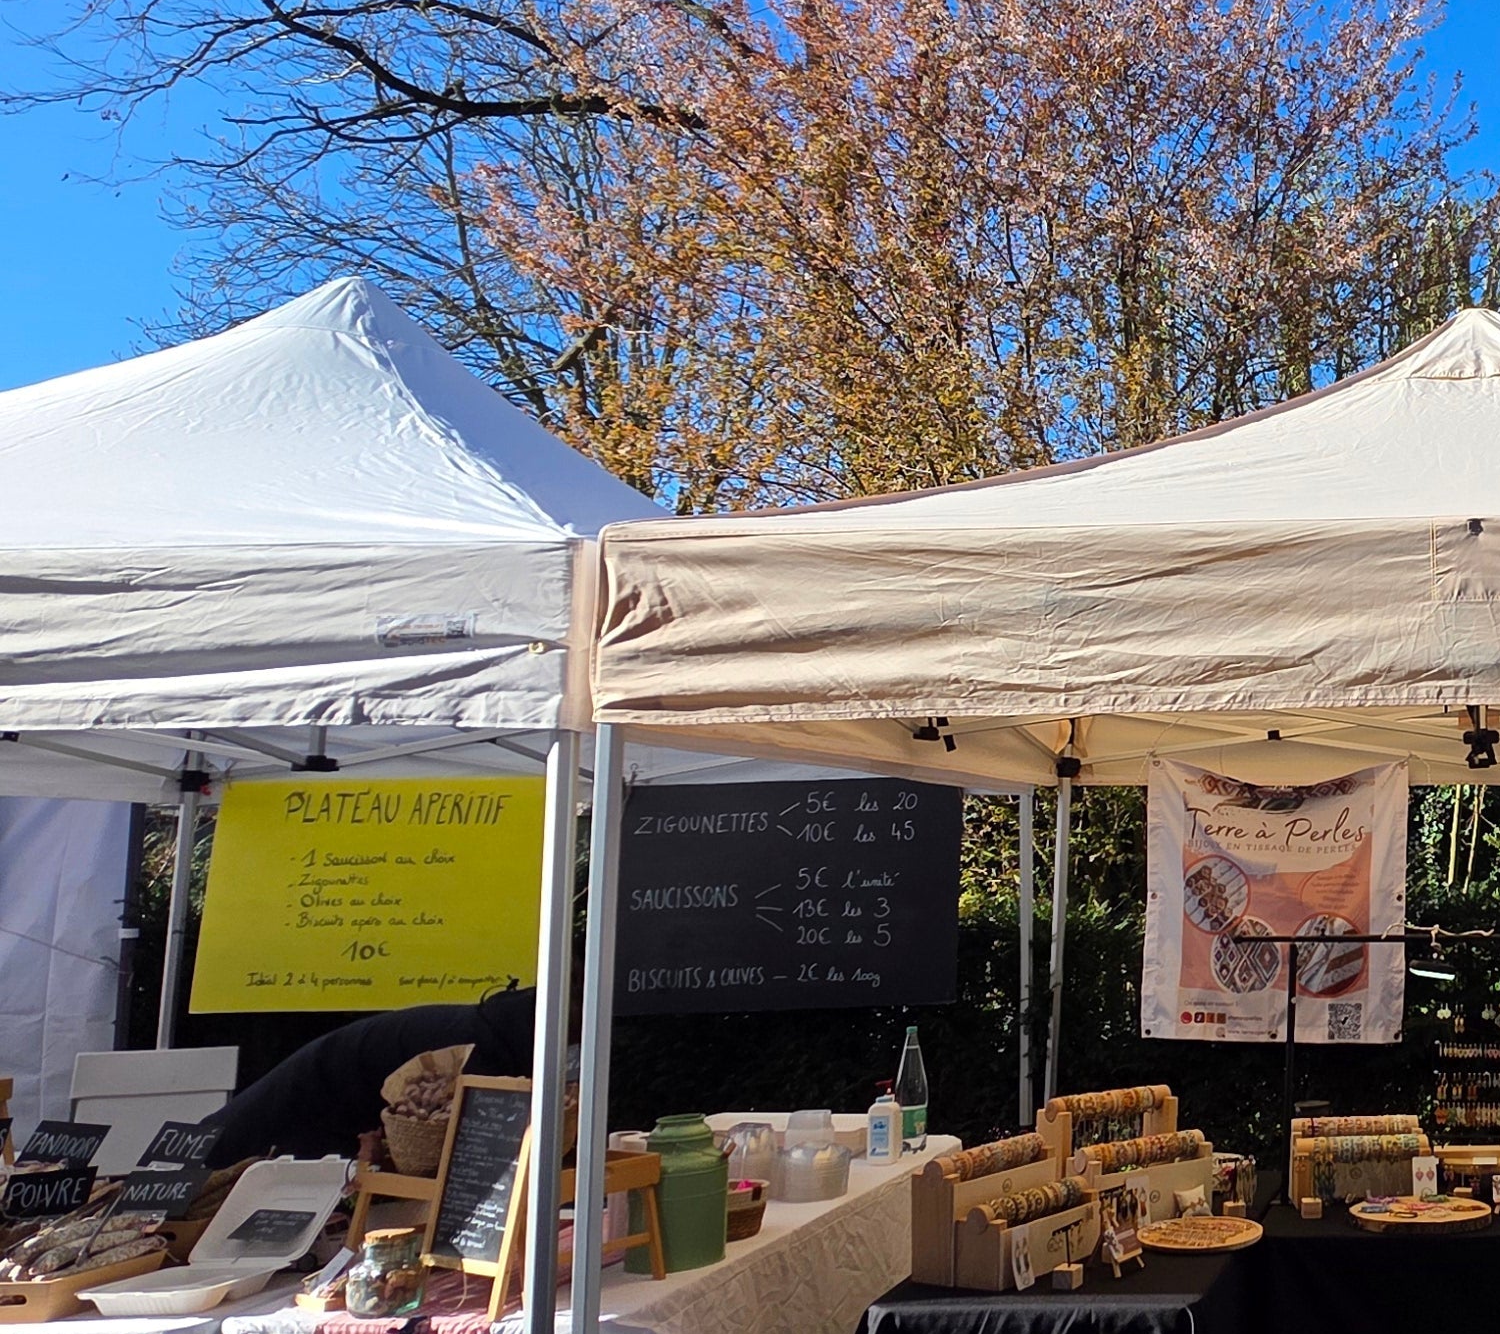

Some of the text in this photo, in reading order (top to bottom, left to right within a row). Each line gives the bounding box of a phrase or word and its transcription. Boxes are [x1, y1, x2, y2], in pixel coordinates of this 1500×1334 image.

[285, 789, 402, 824] PLATEAU
[805, 791, 918, 814] 5€ les 20
[634, 812, 769, 836] ZIGOUNETTES
[796, 821, 915, 843] 10€ les 45
[1185, 807, 1366, 847] Terre à Perles
[301, 848, 317, 867] 1
[395, 855, 417, 865] au
[423, 847, 456, 865] choix
[1227, 842, 1241, 851] EN
[1297, 844, 1312, 854] DE
[1316, 843, 1357, 855] PERLES
[796, 866, 899, 890] 5€ l'unité
[300, 892, 403, 908] Olives au choix
[792, 897, 891, 918] 13€ les 3
[295, 910, 344, 928] Biscuits
[388, 916, 407, 927] au
[411, 910, 445, 927] choix
[796, 923, 892, 947] 20€ les 5
[340, 939, 392, 962] 10€
[283, 971, 294, 987] 2
[310, 971, 319, 987] 4
[627, 966, 702, 992] BISCUITS
[720, 966, 765, 987] OLIVES
[796, 963, 818, 982] 2€
[826, 964, 845, 981] les
[151, 1126, 220, 1160] FUMÉ
[122, 1180, 193, 1203] NATURE
